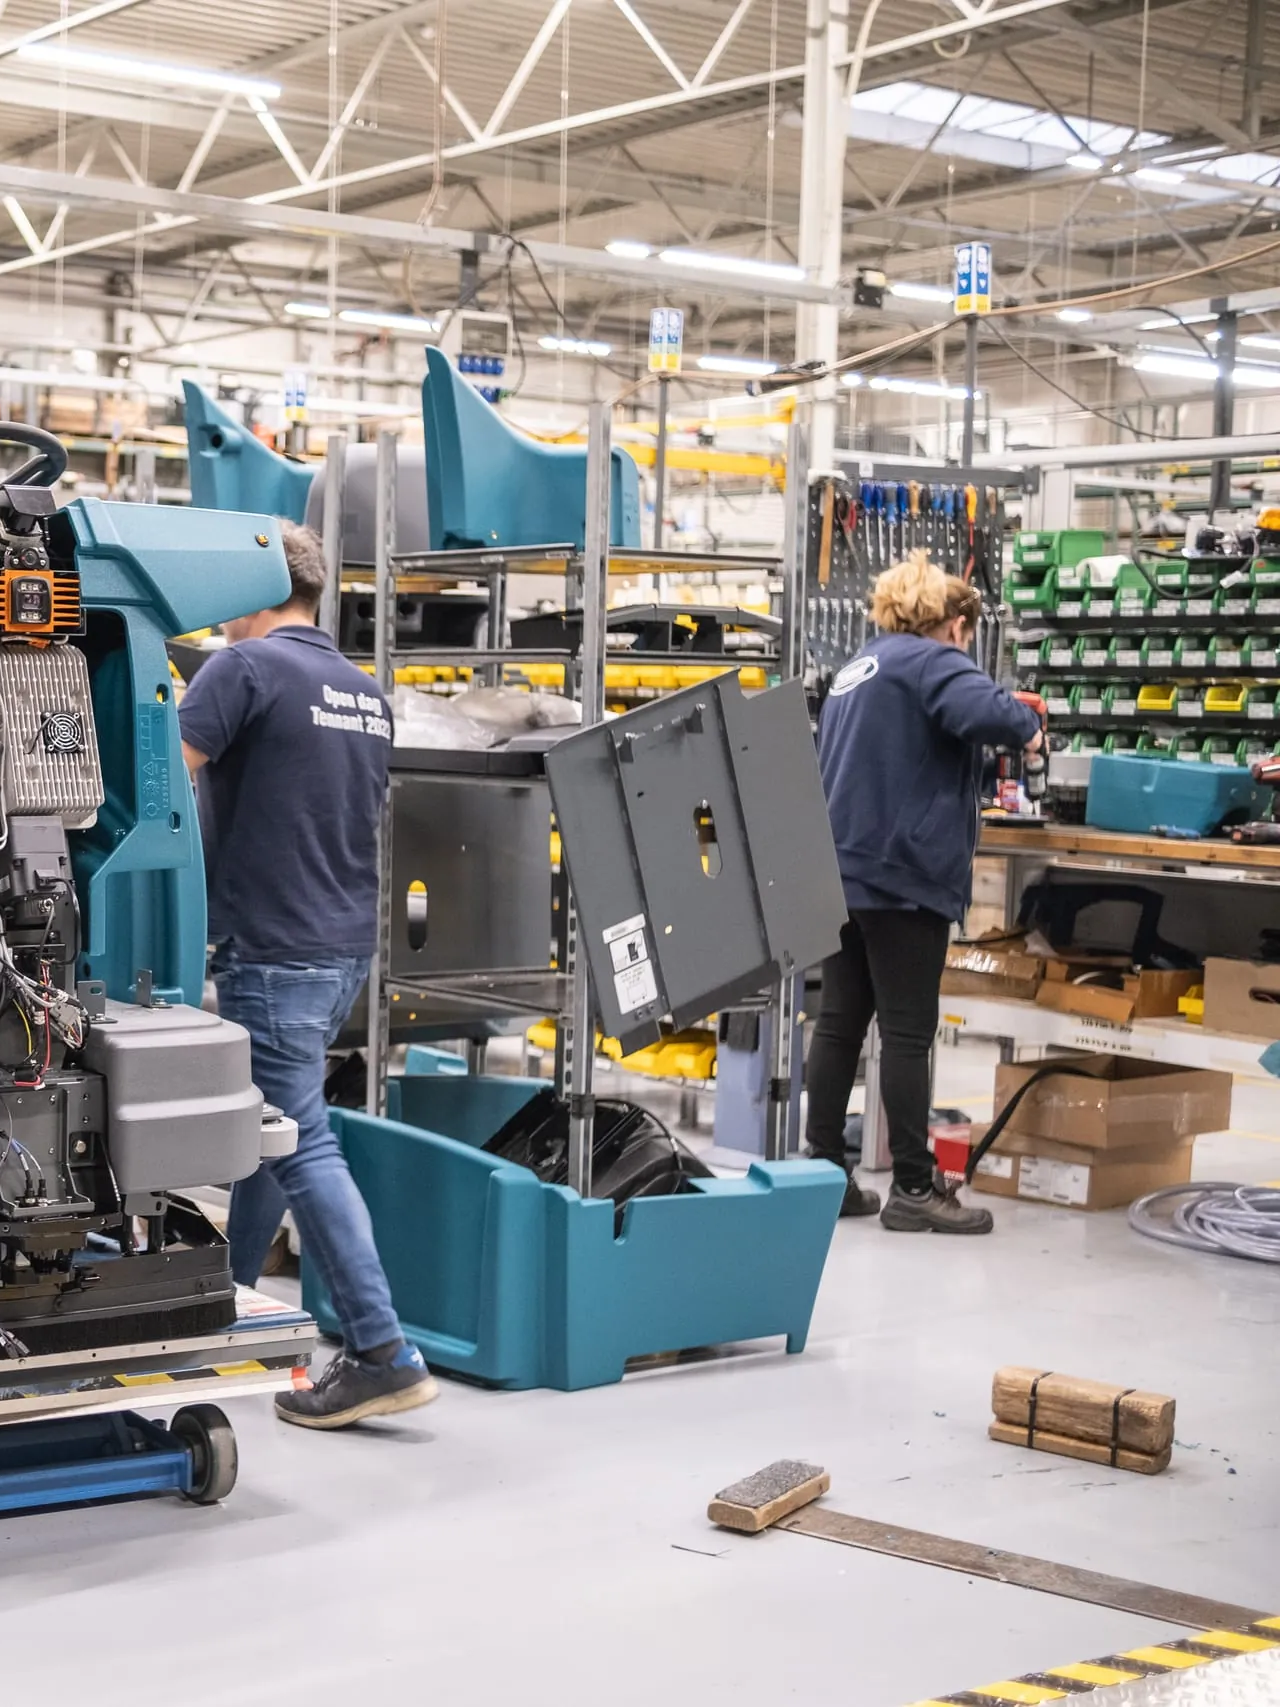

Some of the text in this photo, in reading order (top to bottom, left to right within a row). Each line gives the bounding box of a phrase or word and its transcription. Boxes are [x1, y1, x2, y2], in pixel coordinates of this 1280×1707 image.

[323, 684, 383, 716] Open dag
[310, 705, 365, 733] Tennant
